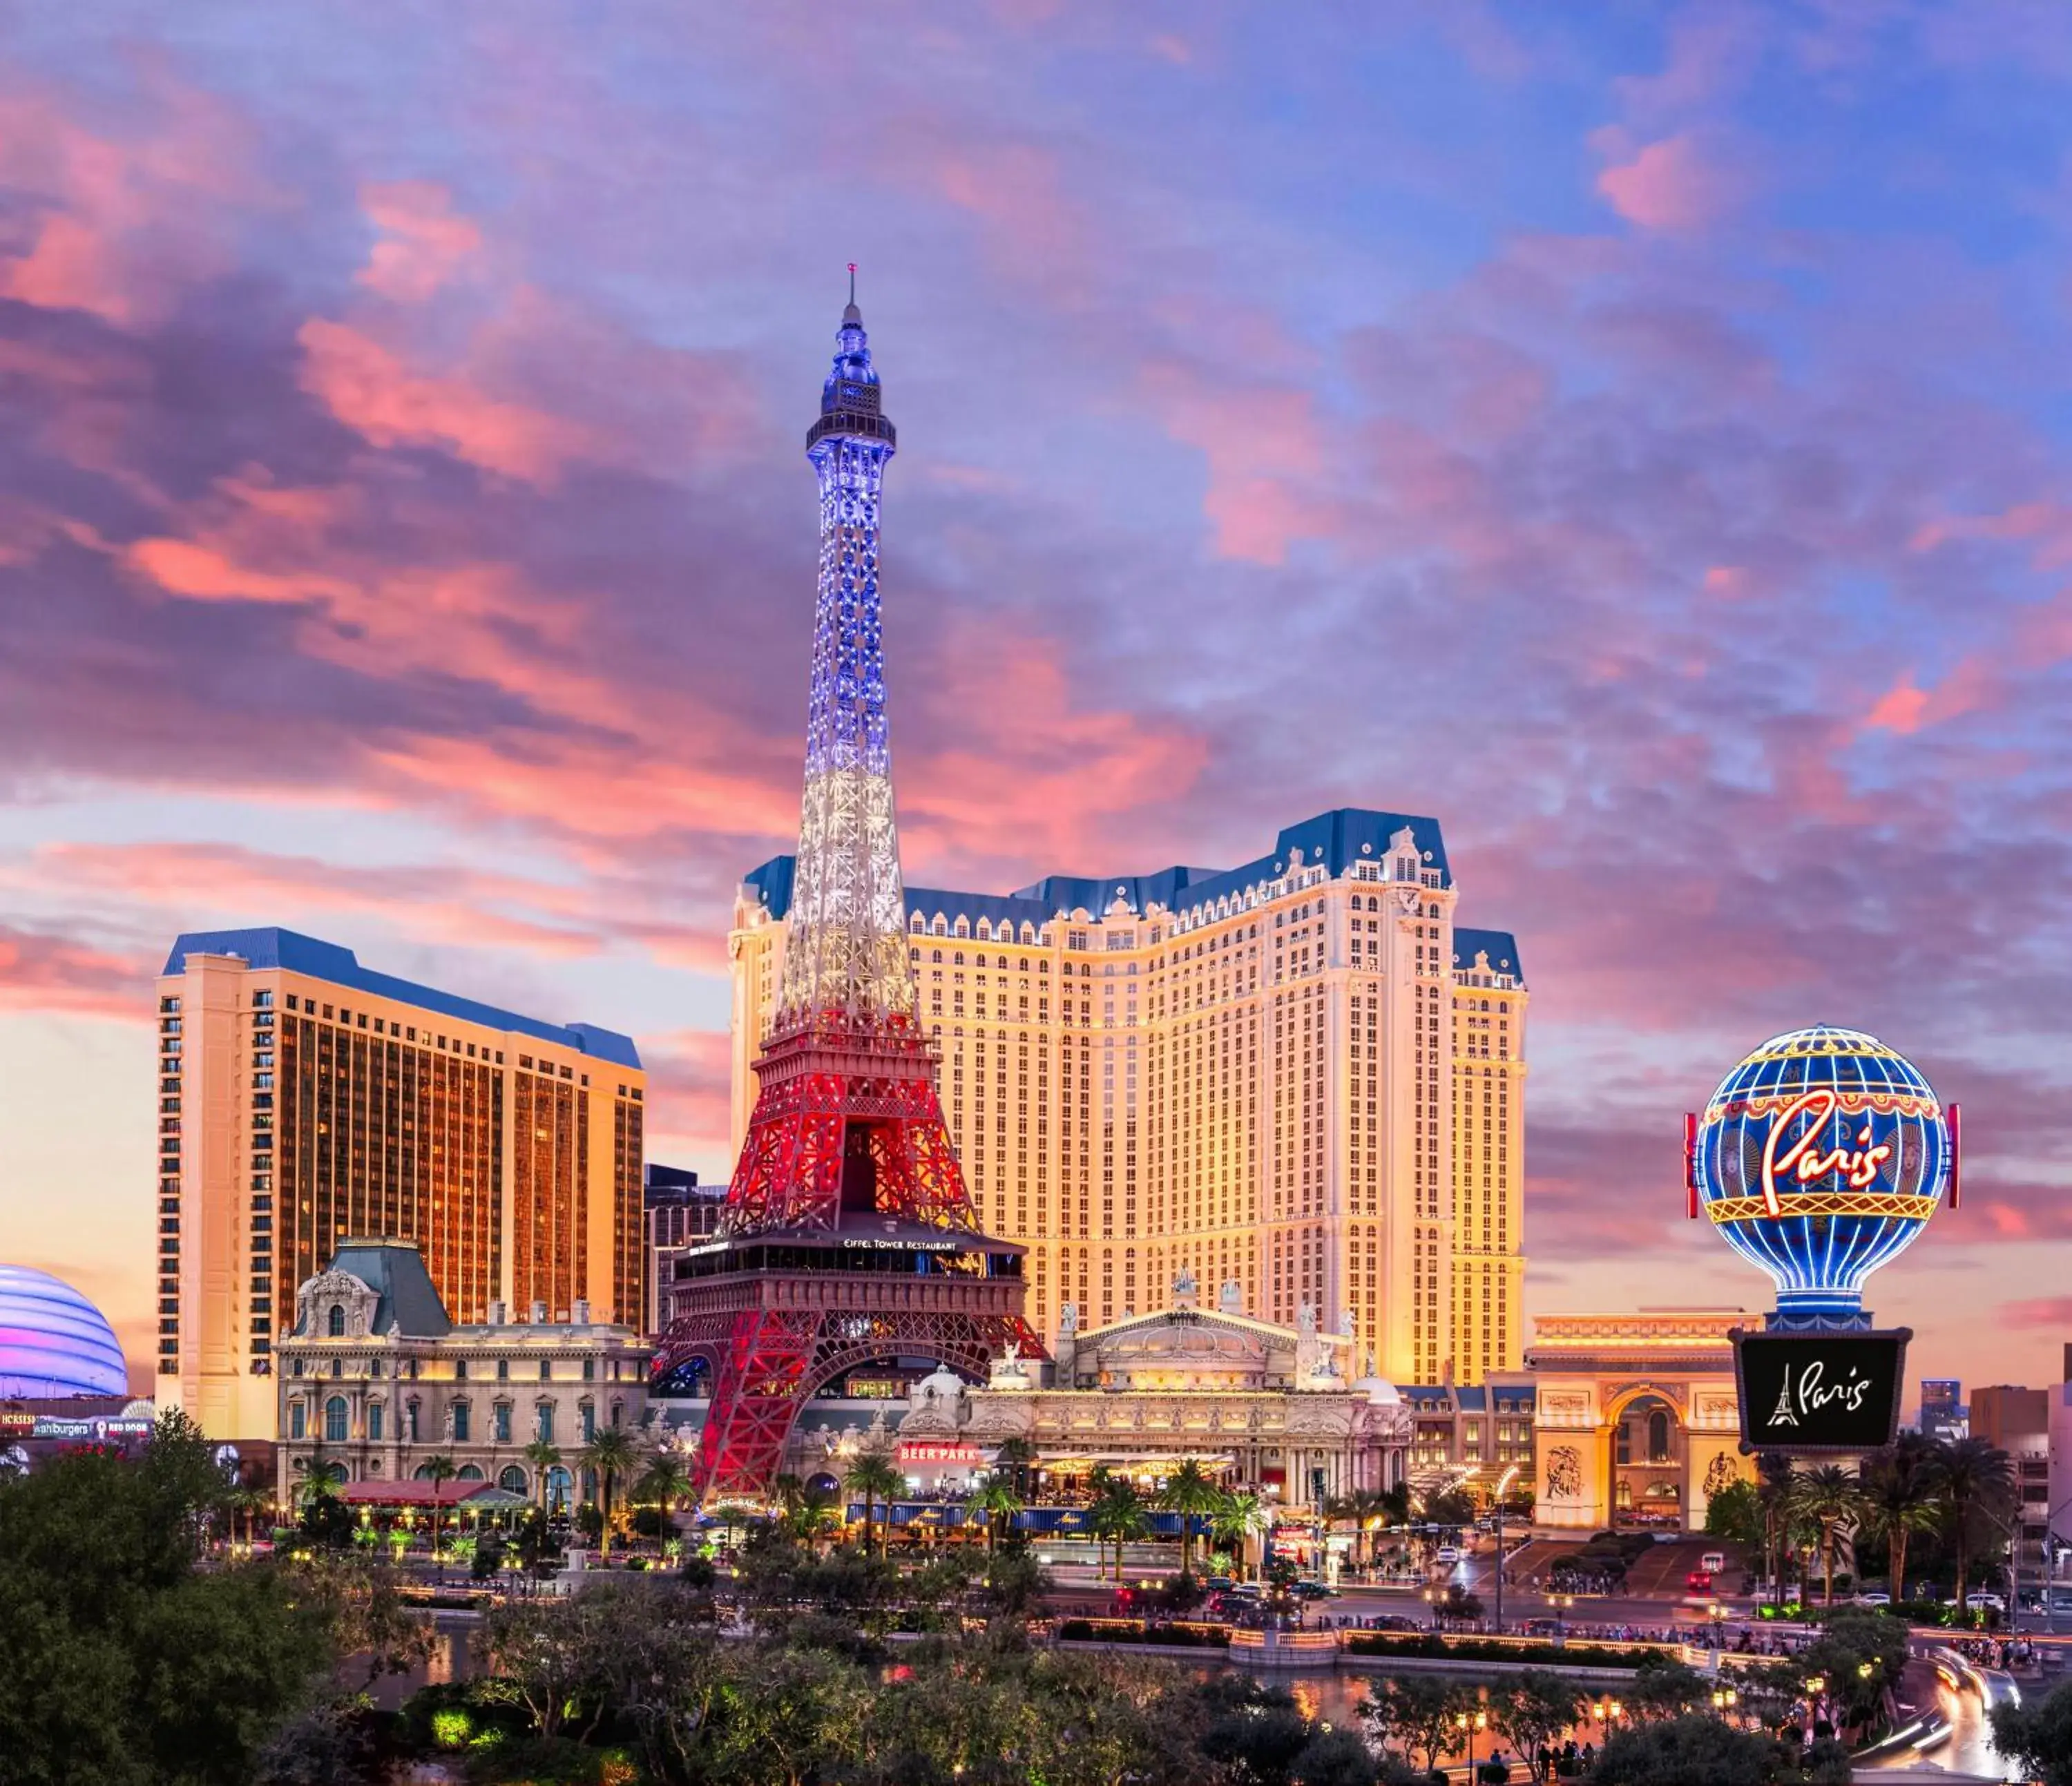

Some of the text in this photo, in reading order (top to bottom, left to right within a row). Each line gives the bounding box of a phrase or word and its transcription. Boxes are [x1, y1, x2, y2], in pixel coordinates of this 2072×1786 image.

[1762, 1089, 1892, 1219] Paris
[843, 1238, 957, 1251] EIFFEL TOWER RESTAURANT
[1798, 1361, 1870, 1414] Paris
[108, 1423, 147, 1432] RED DOOR
[901, 1448, 976, 1461] BEER PARK
